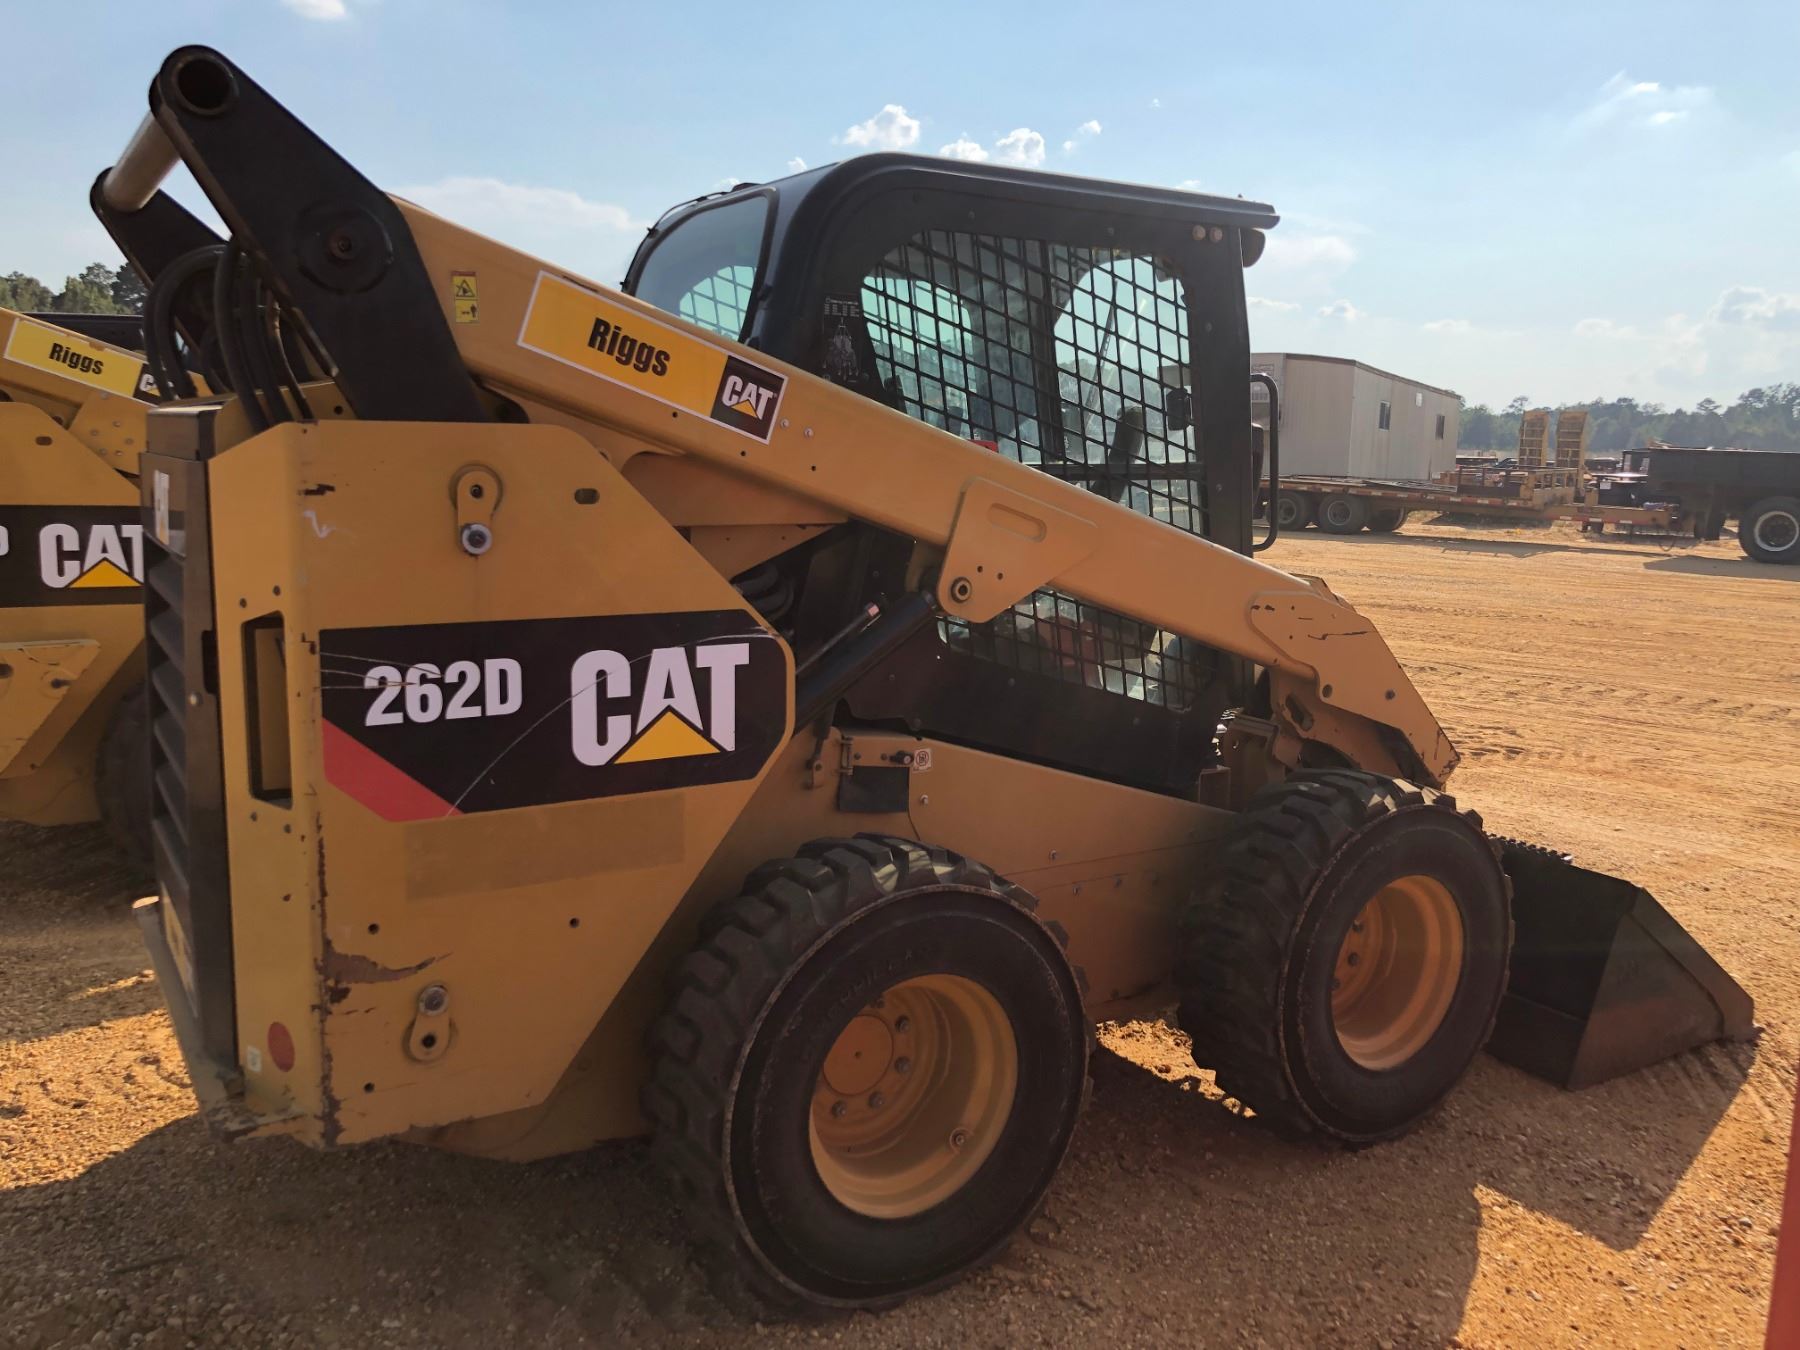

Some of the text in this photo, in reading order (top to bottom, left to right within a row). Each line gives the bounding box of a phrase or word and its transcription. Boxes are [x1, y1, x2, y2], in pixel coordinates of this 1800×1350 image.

[49, 342, 104, 375] Riggs
[587, 317, 775, 420] Riggs CAT
[39, 523, 144, 589] CAT
[363, 643, 750, 767] 262D CAT
